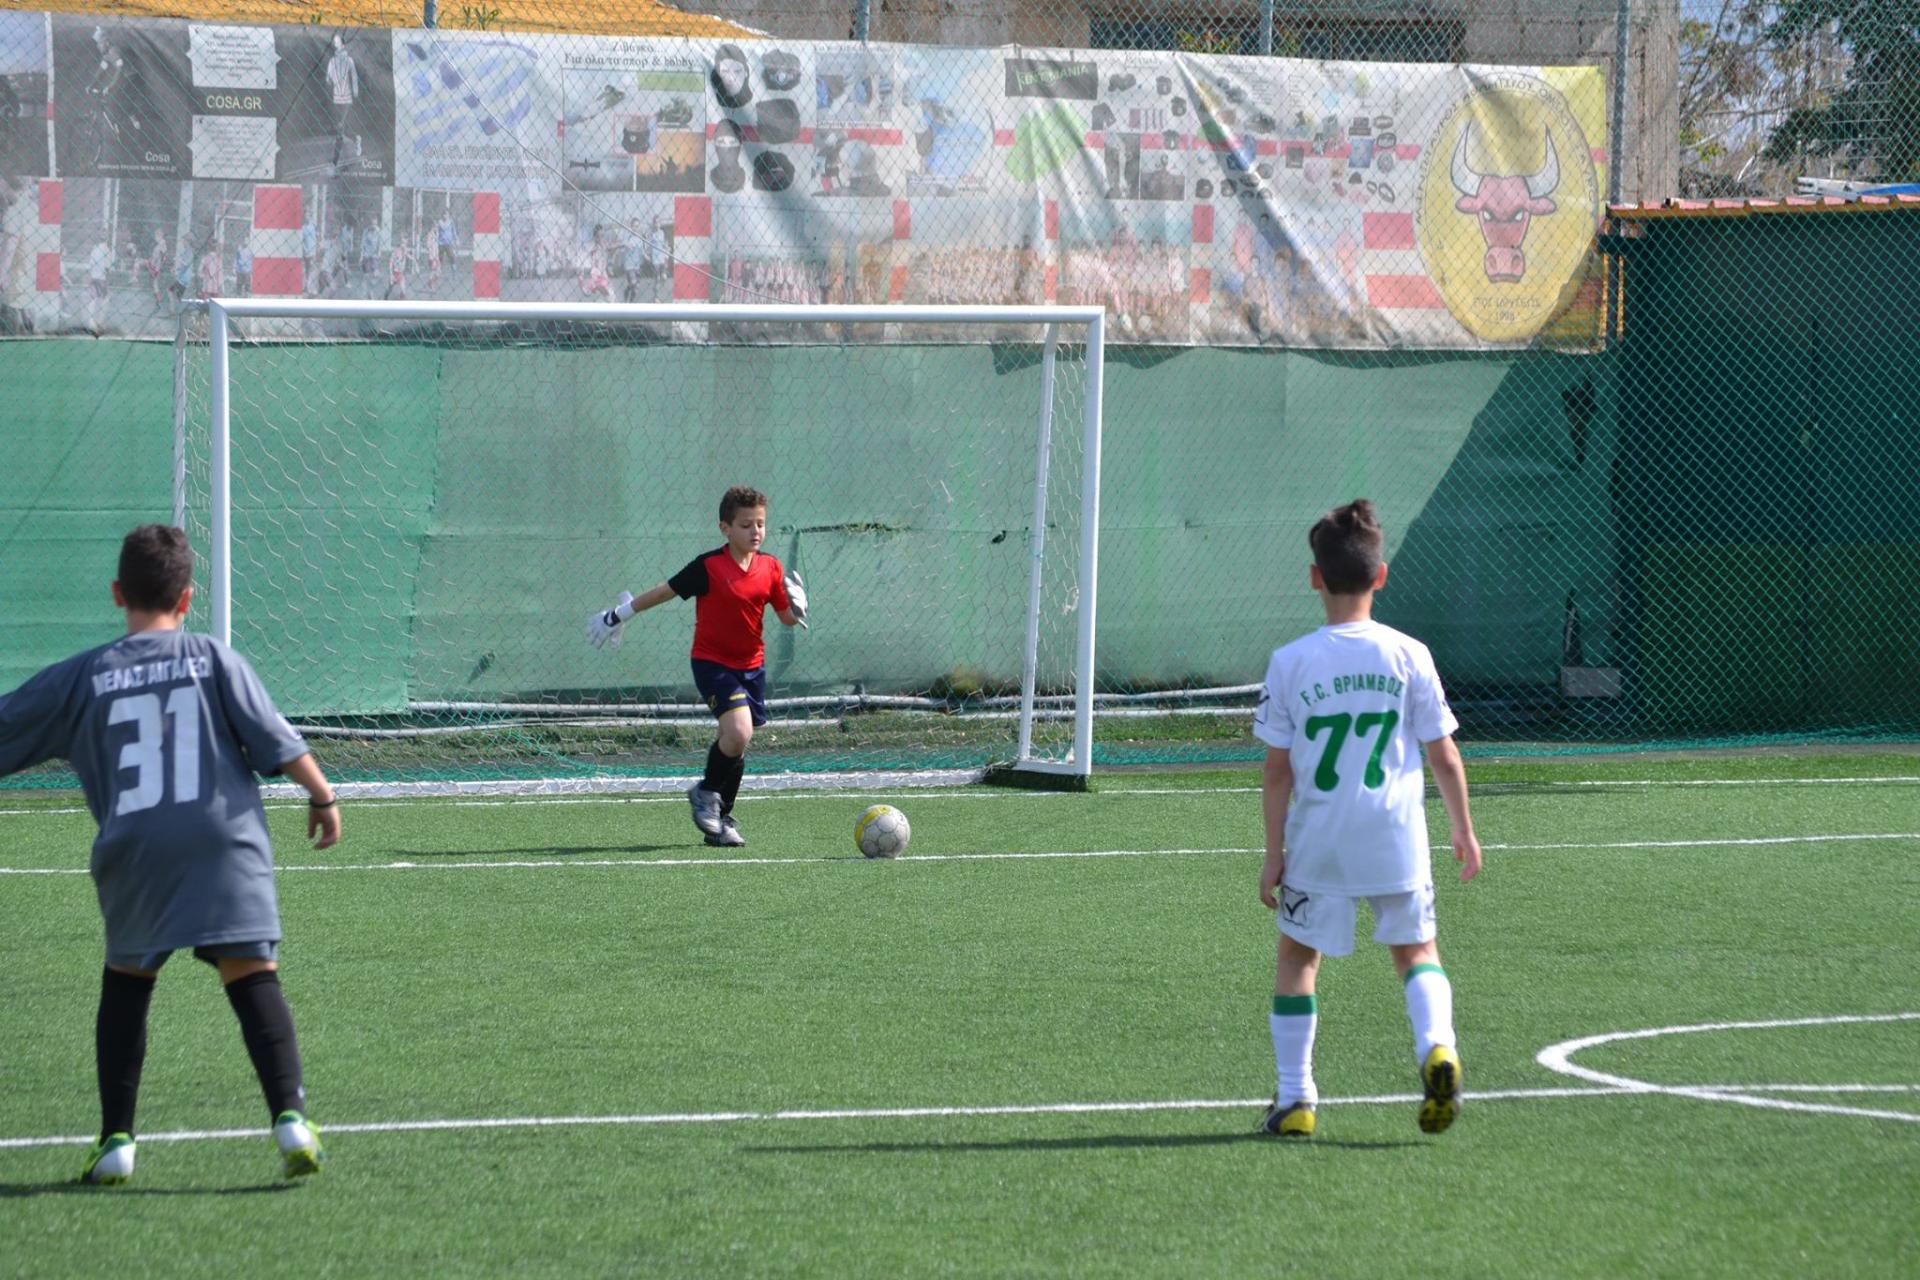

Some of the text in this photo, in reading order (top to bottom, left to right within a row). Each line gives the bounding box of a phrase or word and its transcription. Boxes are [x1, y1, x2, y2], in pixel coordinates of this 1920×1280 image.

[206, 94, 263, 110] COSA.GR
[108, 686, 199, 816] 31
[1305, 709, 1398, 792] 77
